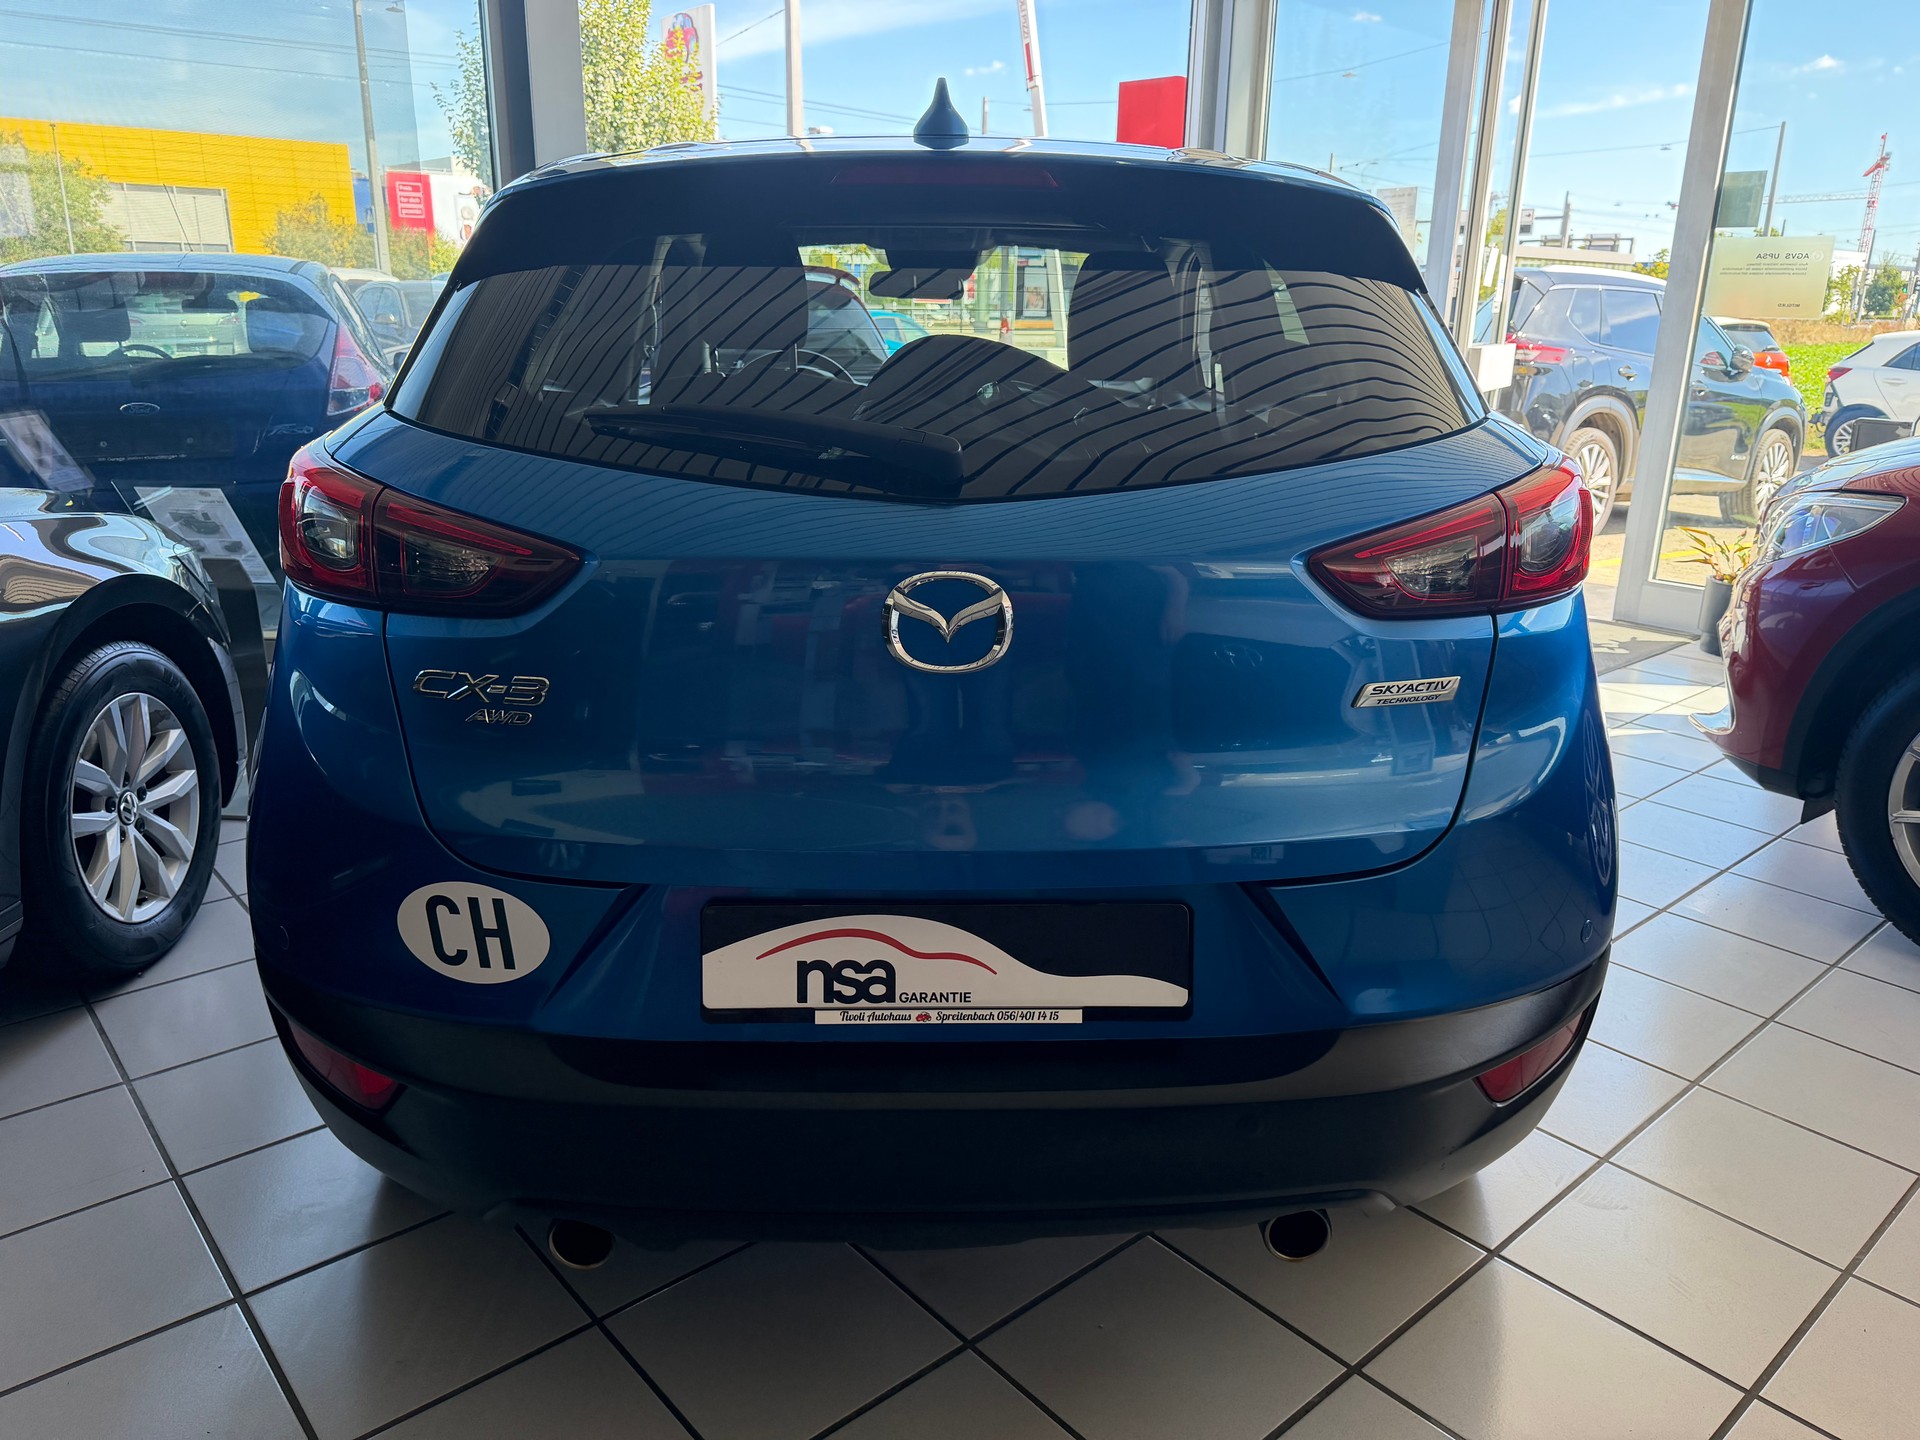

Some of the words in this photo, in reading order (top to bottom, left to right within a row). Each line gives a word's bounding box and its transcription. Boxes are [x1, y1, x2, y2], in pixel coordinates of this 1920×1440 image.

[413, 669, 550, 706] CX-3
[1370, 680, 1452, 696] SKYACTIV
[1377, 694, 1441, 705] TECHNOLOGY
[465, 708, 533, 726] AWD
[425, 894, 516, 970] CH
[797, 959, 896, 1004] nsa
[899, 992, 972, 1003] GARANTIE
[839, 1010, 865, 1022] Tivoli
[867, 1011, 912, 1021] Autohaus
[936, 1011, 994, 1023] Spreitenbach
[997, 1011, 1035, 1021] 056/401
[1037, 1011, 1047, 1021] 14
[1049, 1011, 1059, 1021] 15
